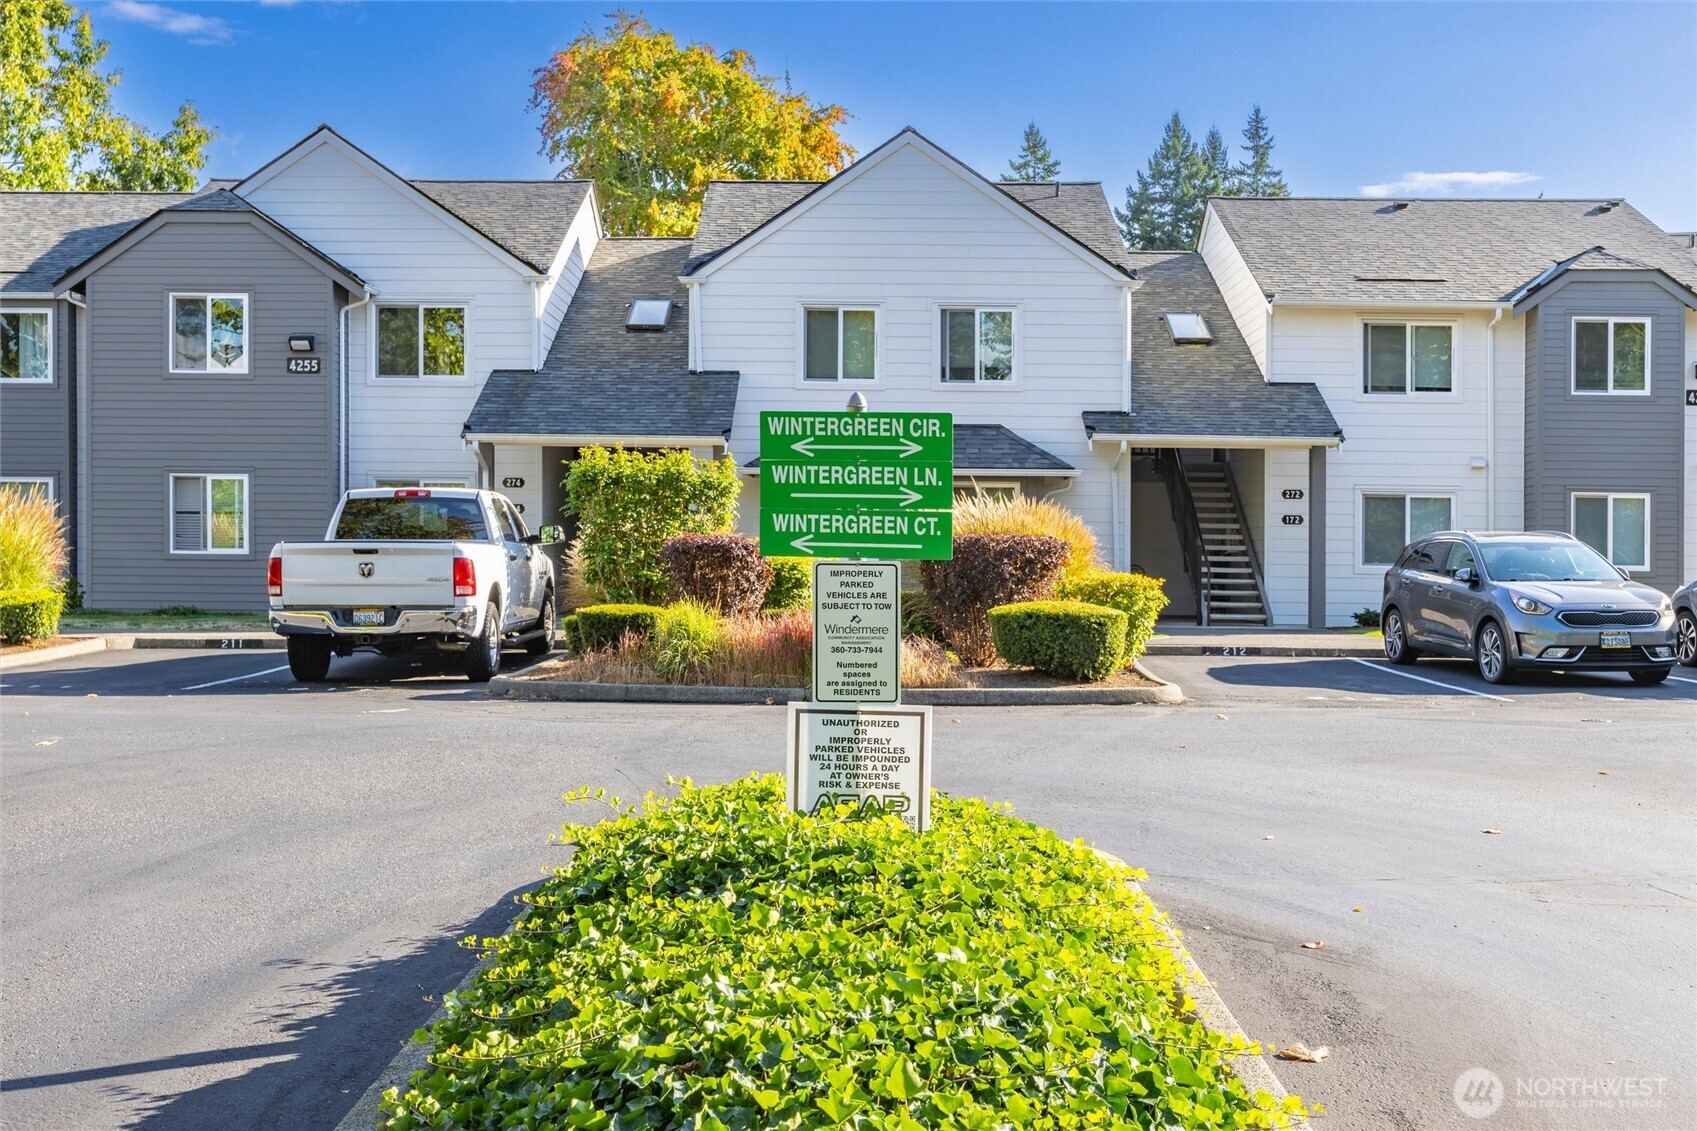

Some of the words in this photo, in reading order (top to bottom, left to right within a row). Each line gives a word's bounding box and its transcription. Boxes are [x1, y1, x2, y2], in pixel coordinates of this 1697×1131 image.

[290, 360, 318, 371] 4255
[1688, 392, 1697, 403] 4
[767, 416, 904, 437] WINTERGREEN
[909, 418, 946, 437] CIR.
[771, 465, 908, 486] WINTERGREEN
[914, 467, 942, 486] LN.
[506, 479, 521, 487] 274
[772, 513, 908, 534] WINTERGREEN
[914, 517, 941, 536] CT.
[1286, 516, 1300, 524] 172
[830, 570, 883, 578] IMPROPERLY
[821, 602, 860, 610] SUBJECT
[824, 624, 888, 634] Windermere
[221, 638, 243, 648] 211
[831, 646, 883, 654] 360-733-7944
[1223, 647, 1246, 656] 212
[836, 661, 878, 669] Numbered
[841, 680, 878, 688] assigned
[822, 719, 900, 728] UNAUTHORIZED
[829, 737, 892, 745] IMPROPERLY
[815, 745, 854, 753] PARKED
[857, 746, 906, 754] VEHICLES
[809, 754, 833, 762] WILL
[836, 754, 849, 762] BE
[852, 755, 911, 764] IMPOUNDED
[819, 763, 831, 771] 24
[834, 763, 868, 771] HOURS
[881, 764, 900, 772] DAY
[830, 772, 842, 780] AT
[845, 772, 890, 780] OWNER'S
[855, 782, 900, 790] EXPENSE
